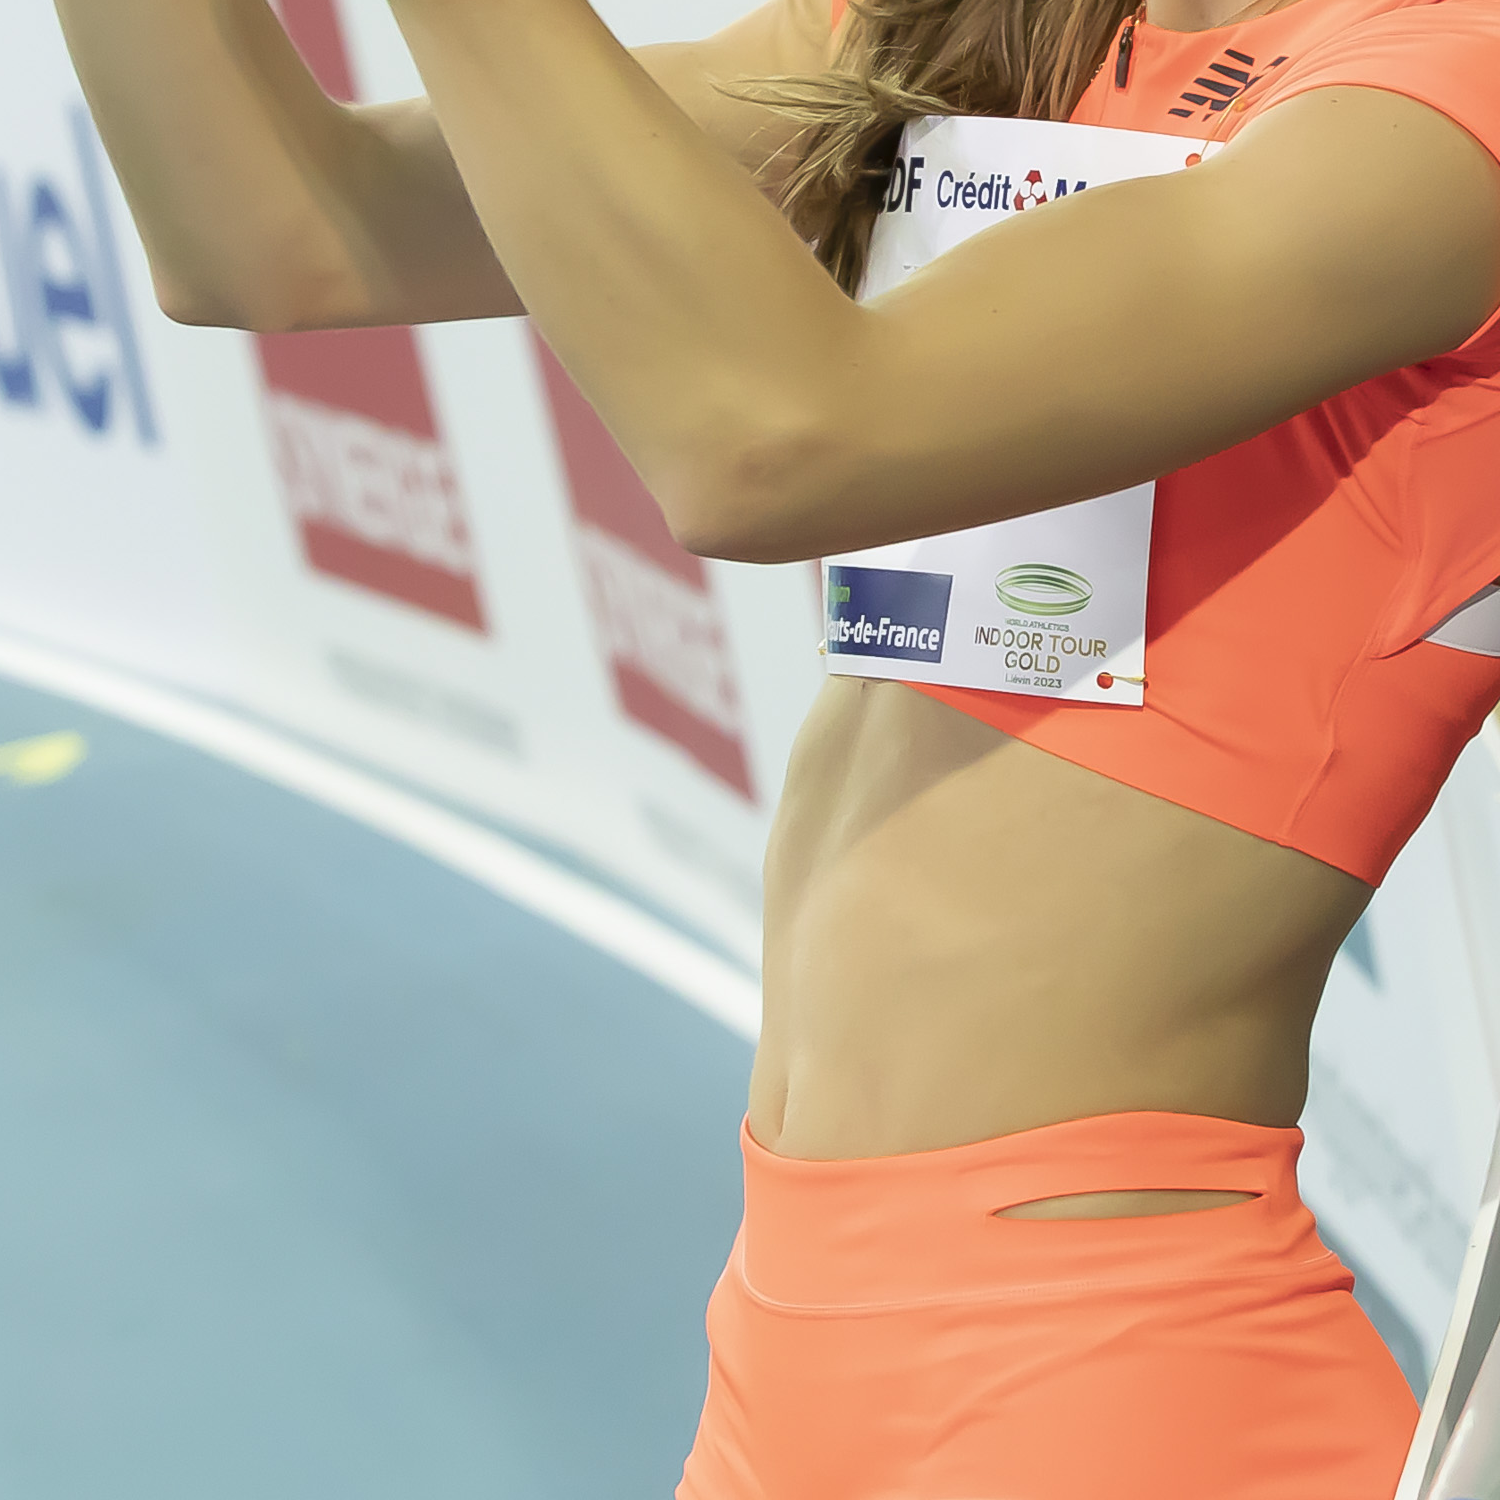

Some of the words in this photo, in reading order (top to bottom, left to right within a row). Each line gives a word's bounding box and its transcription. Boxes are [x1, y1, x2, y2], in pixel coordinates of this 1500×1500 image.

[878, 157, 924, 213] DF
[937, 169, 1012, 211] Crédit
[828, 614, 940, 651] auts-de-France
[1029, 620, 1070, 632] ATHLETICS
[974, 626, 1043, 651] INDOOR
[1049, 634, 1107, 658] TOUR
[1004, 650, 1061, 674] GOLD
[1033, 676, 1062, 689] 2023
